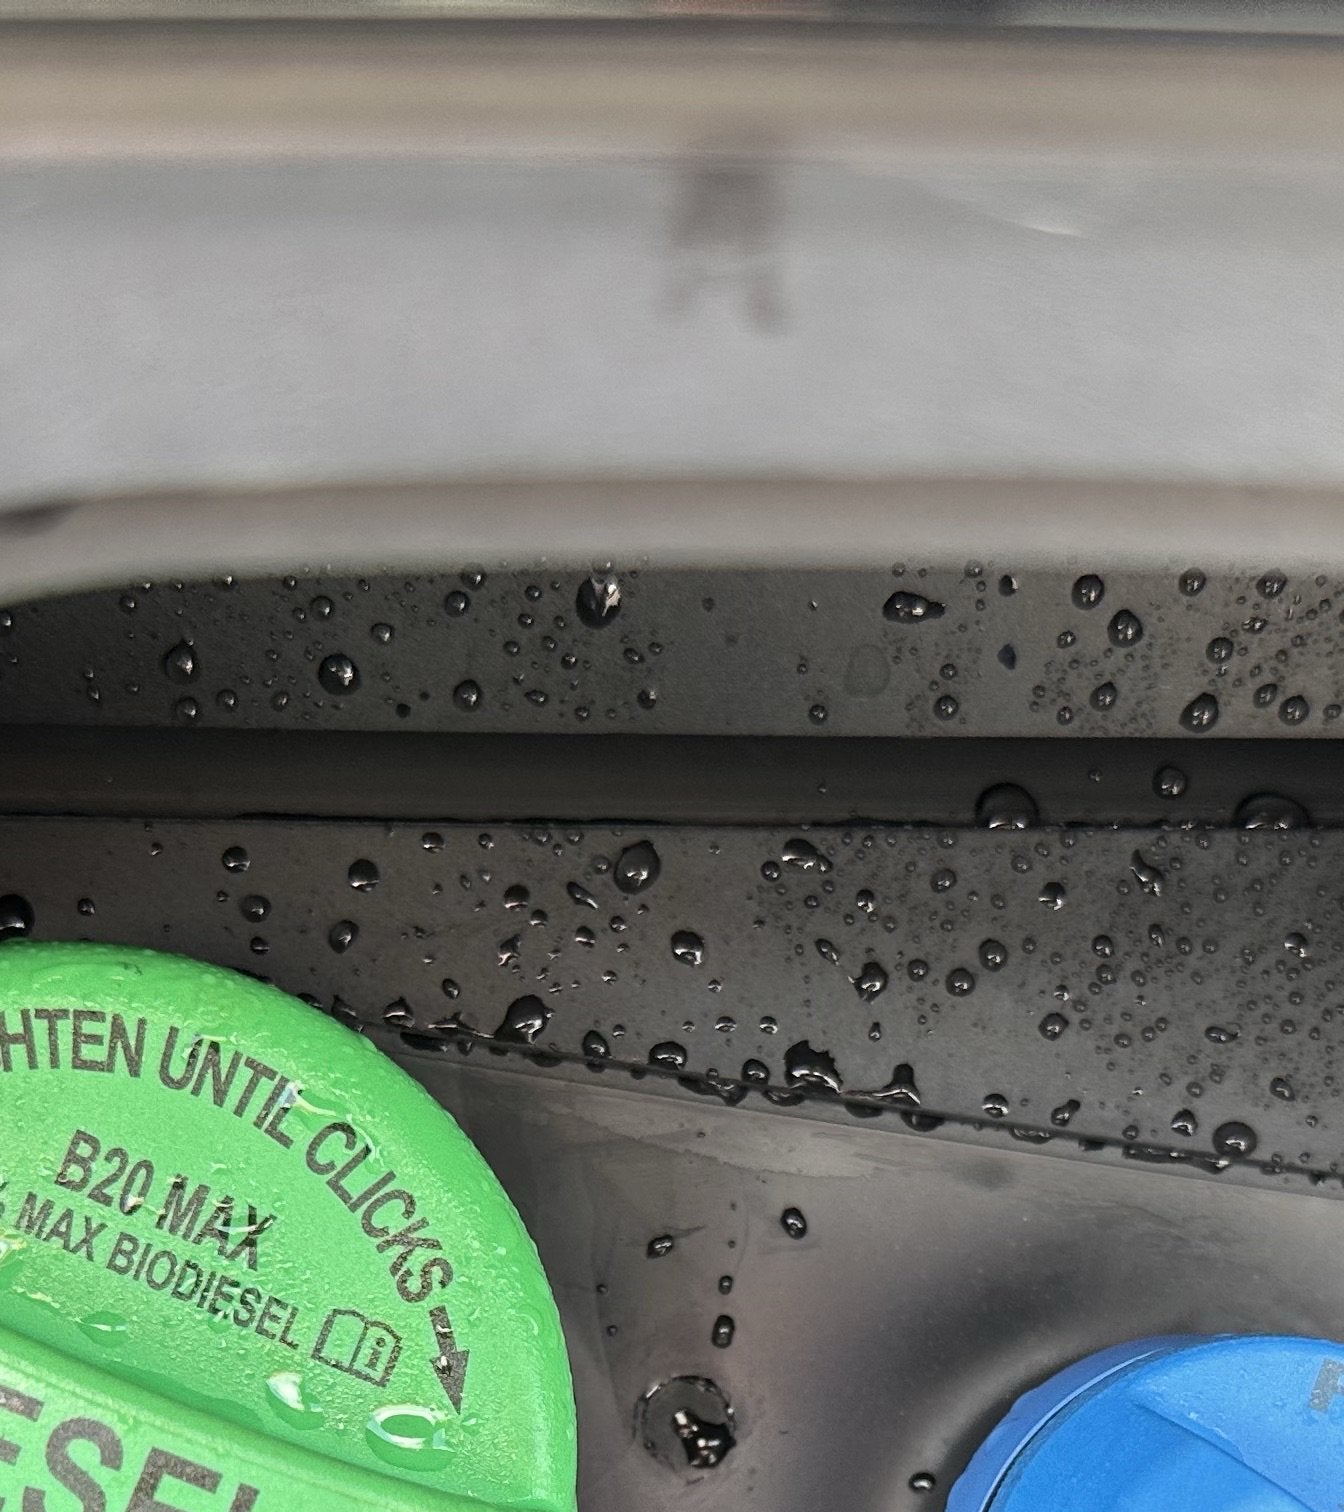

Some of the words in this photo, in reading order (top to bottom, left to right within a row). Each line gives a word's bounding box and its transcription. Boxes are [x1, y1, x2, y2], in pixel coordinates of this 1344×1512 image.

[54, 1129, 155, 1216] B20
[156, 1174, 276, 1270] MAX
[158, 1026, 295, 1149] UNTIL
[306, 1122, 454, 1303] CLICKS
[16, 1189, 107, 1262] MAX
[109, 1225, 299, 1350] BIODIESEL
